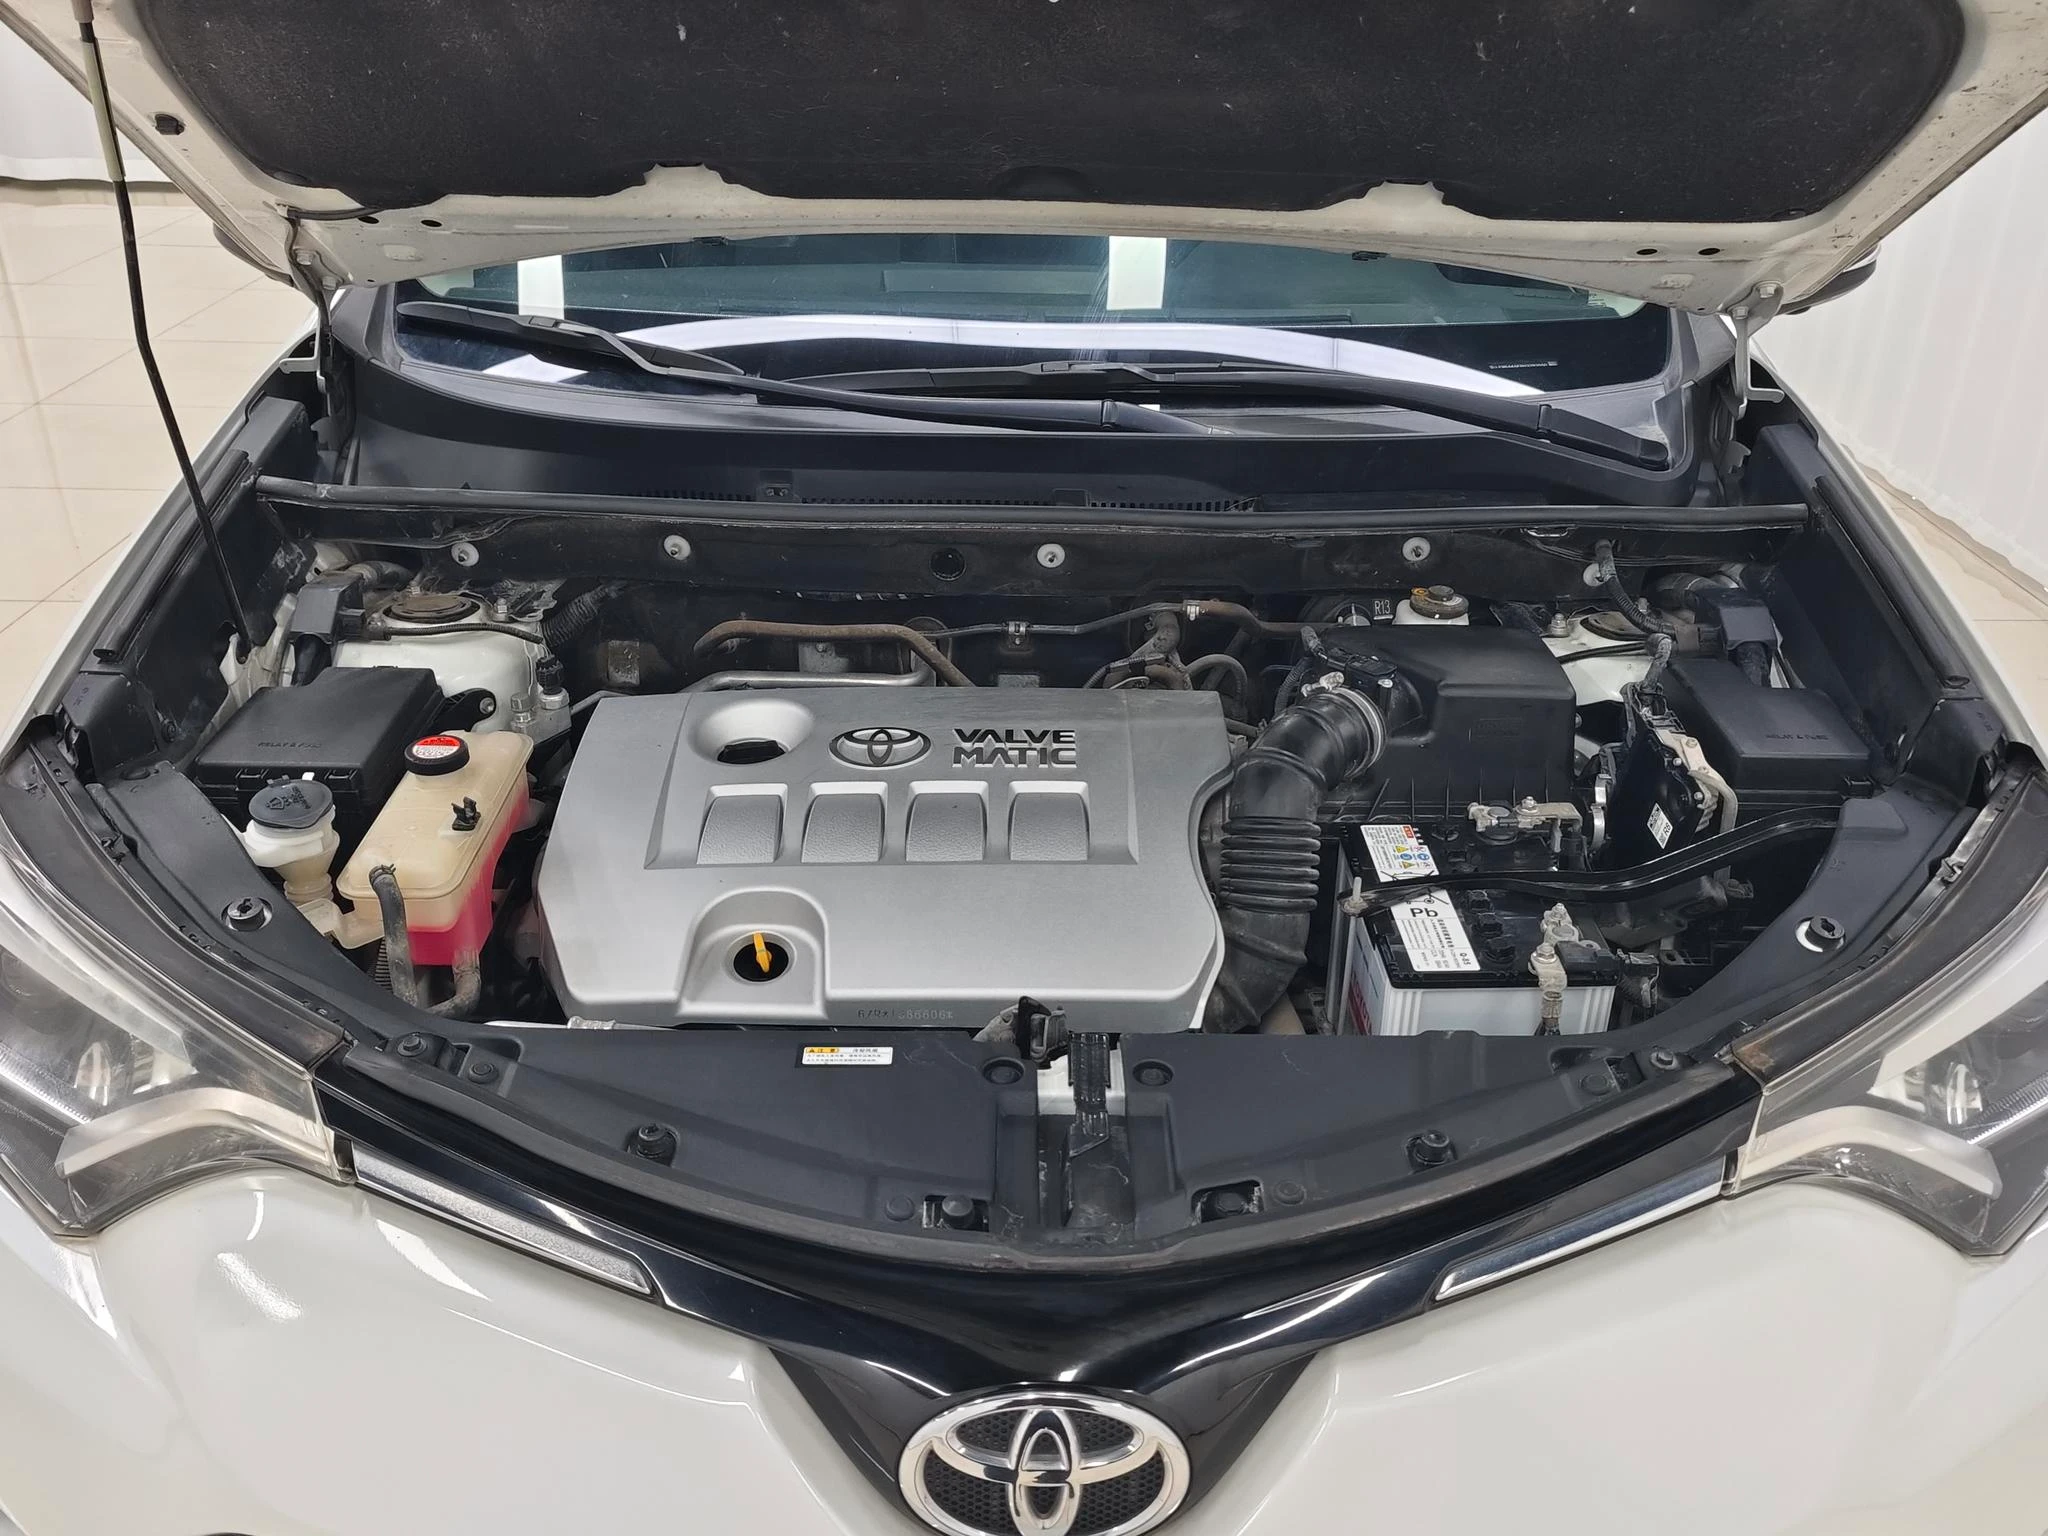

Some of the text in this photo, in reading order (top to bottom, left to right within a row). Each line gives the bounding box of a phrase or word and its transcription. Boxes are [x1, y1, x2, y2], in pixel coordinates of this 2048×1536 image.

[1374, 600, 1390, 614] R13
[953, 728, 1076, 745] VALVE
[952, 747, 1077, 768] MATIC
[1409, 907, 1439, 918] Pb
